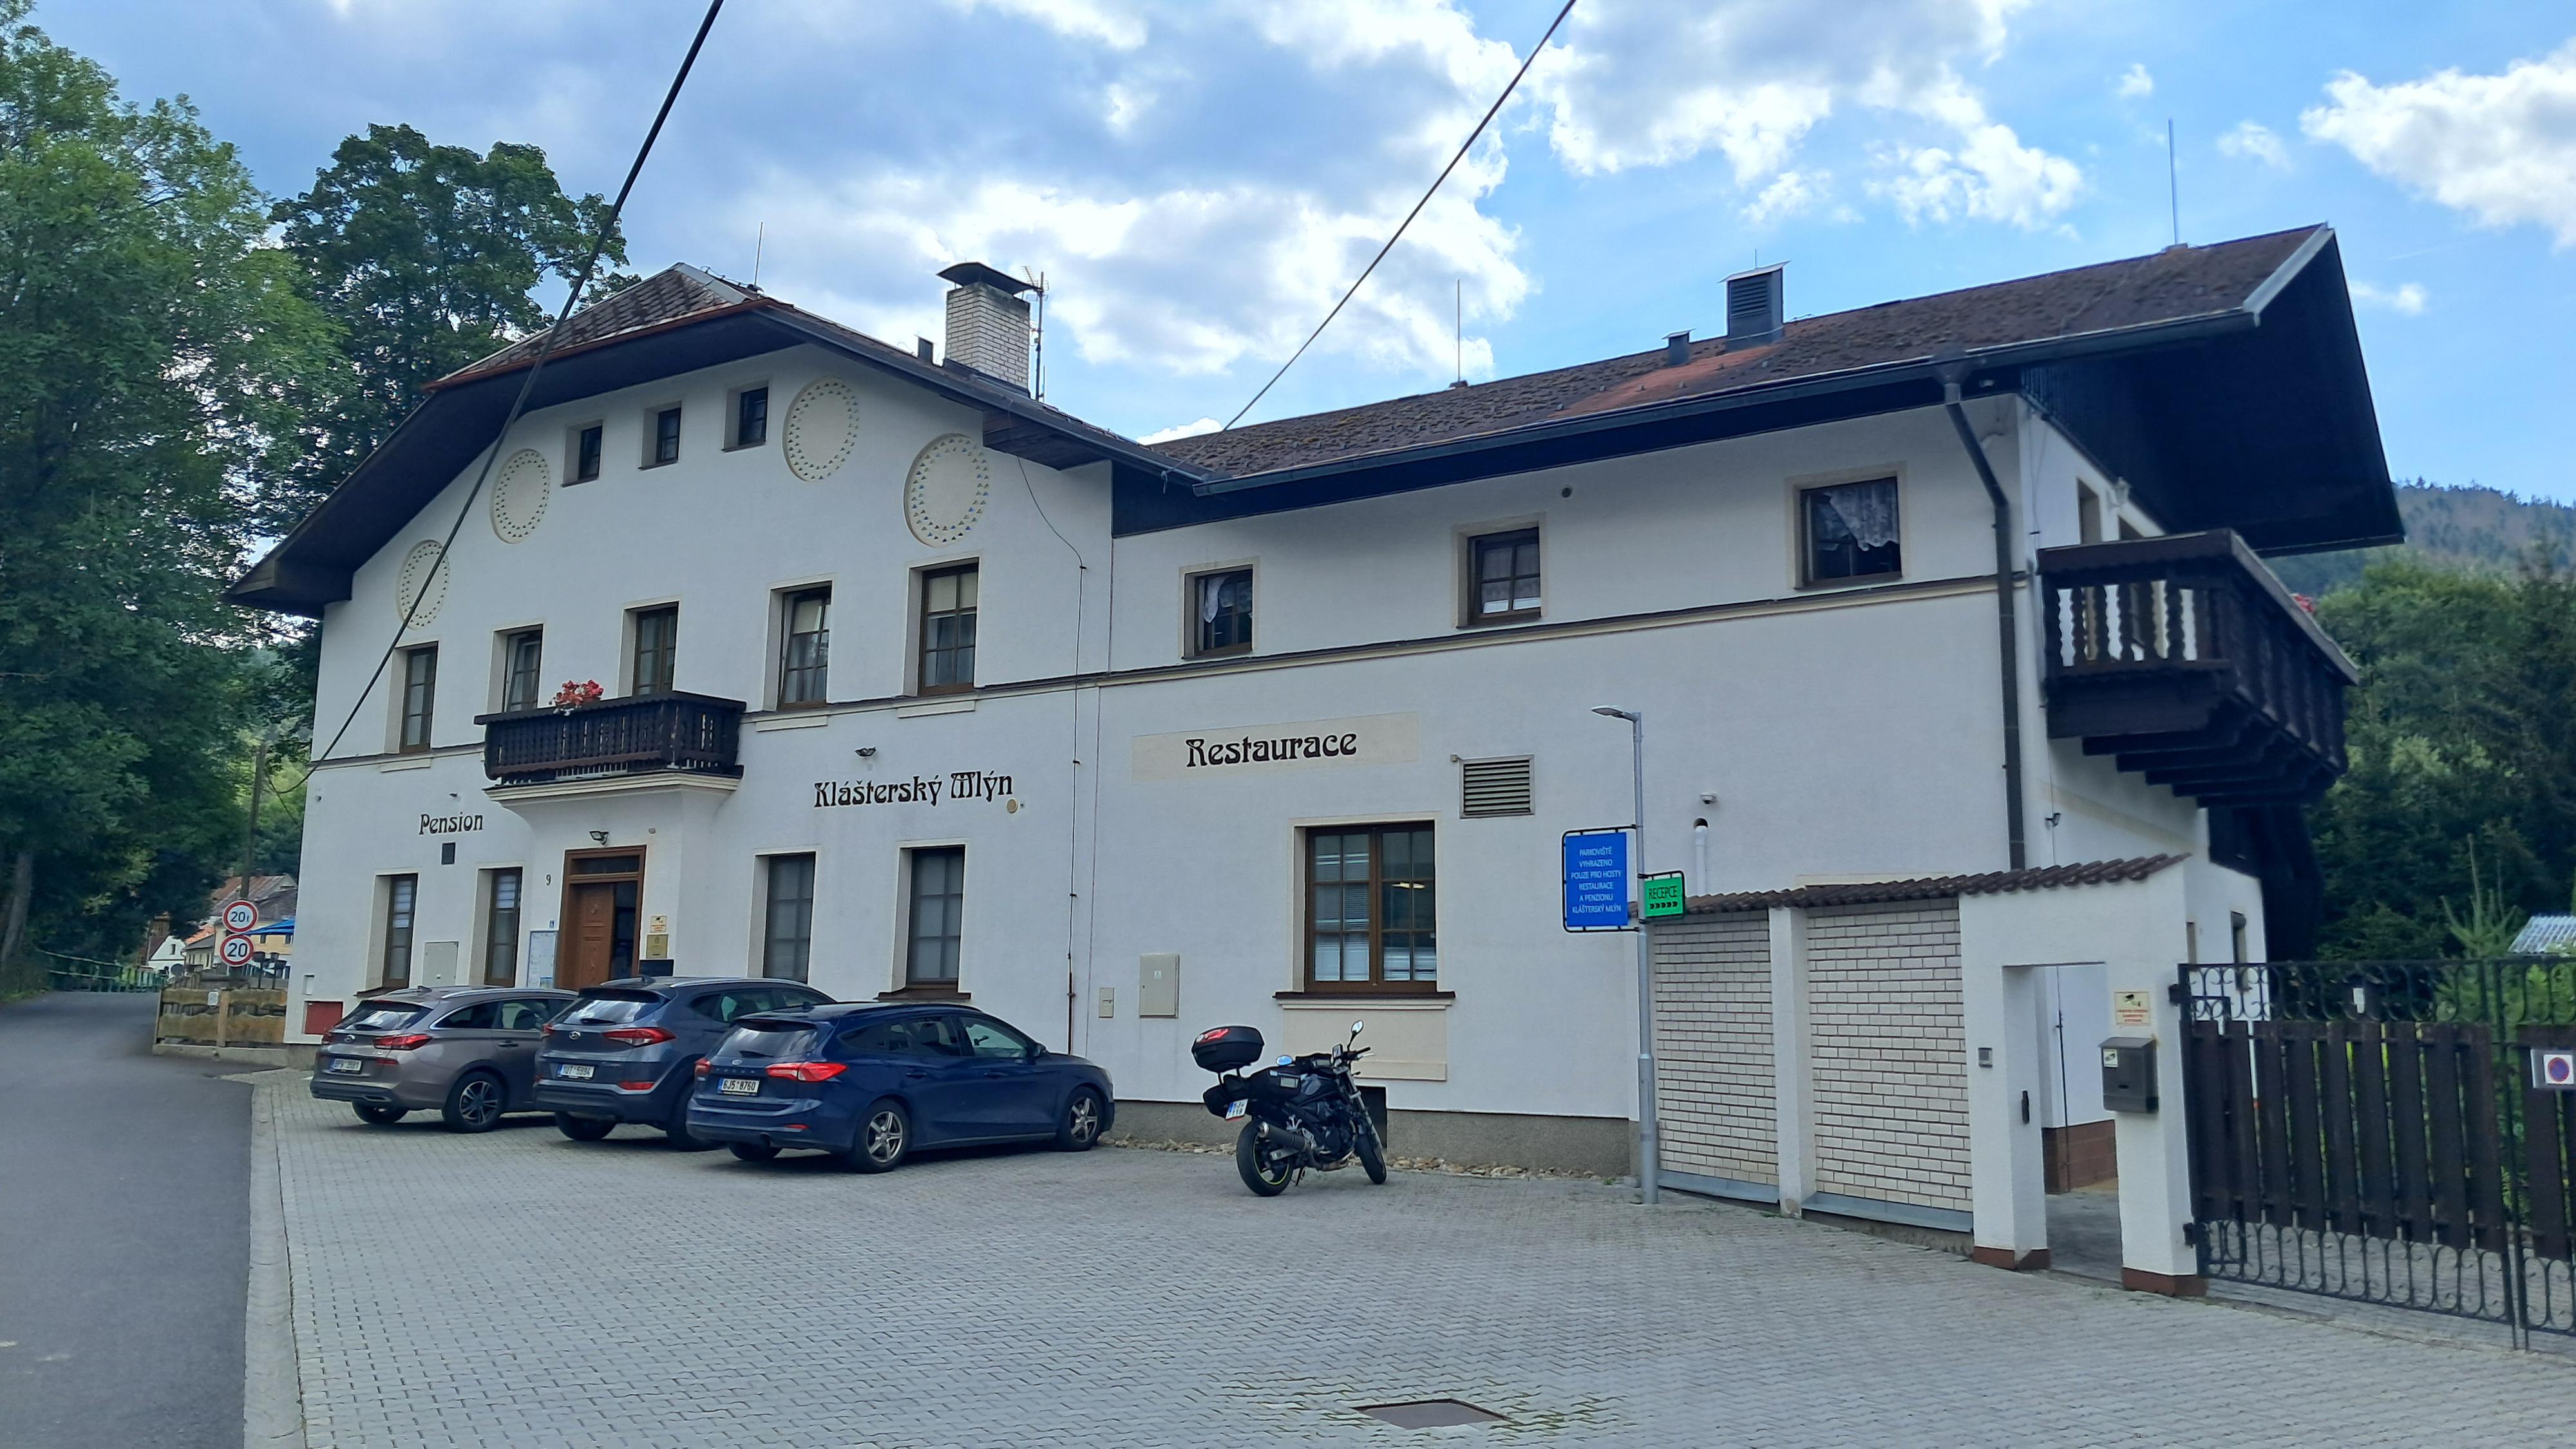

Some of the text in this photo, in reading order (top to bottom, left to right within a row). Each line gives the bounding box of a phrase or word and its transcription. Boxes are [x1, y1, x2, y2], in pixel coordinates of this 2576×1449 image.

[1186, 733, 1357, 767] Restaurace
[813, 770, 1013, 808] Klášterský Mlýn
[418, 811, 483, 835] Pension
[1579, 846, 1613, 856] PARKOVIŠTĚ
[1578, 859, 1613, 868] VYHRAZENO
[545, 874, 551, 886] 9
[1590, 871, 1602, 879] PRO
[1603, 869, 1622, 878] HOSTY
[1578, 882, 1614, 891] RESTAURACE
[1585, 893, 1613, 902] PENZIONU
[1649, 886, 1678, 900] RECEPCE
[1572, 903, 1622, 913] KLÁŠTERSKÝ MLÝN
[227, 942, 248, 958] 20
[723, 1079, 756, 1091] 6J5 8760
